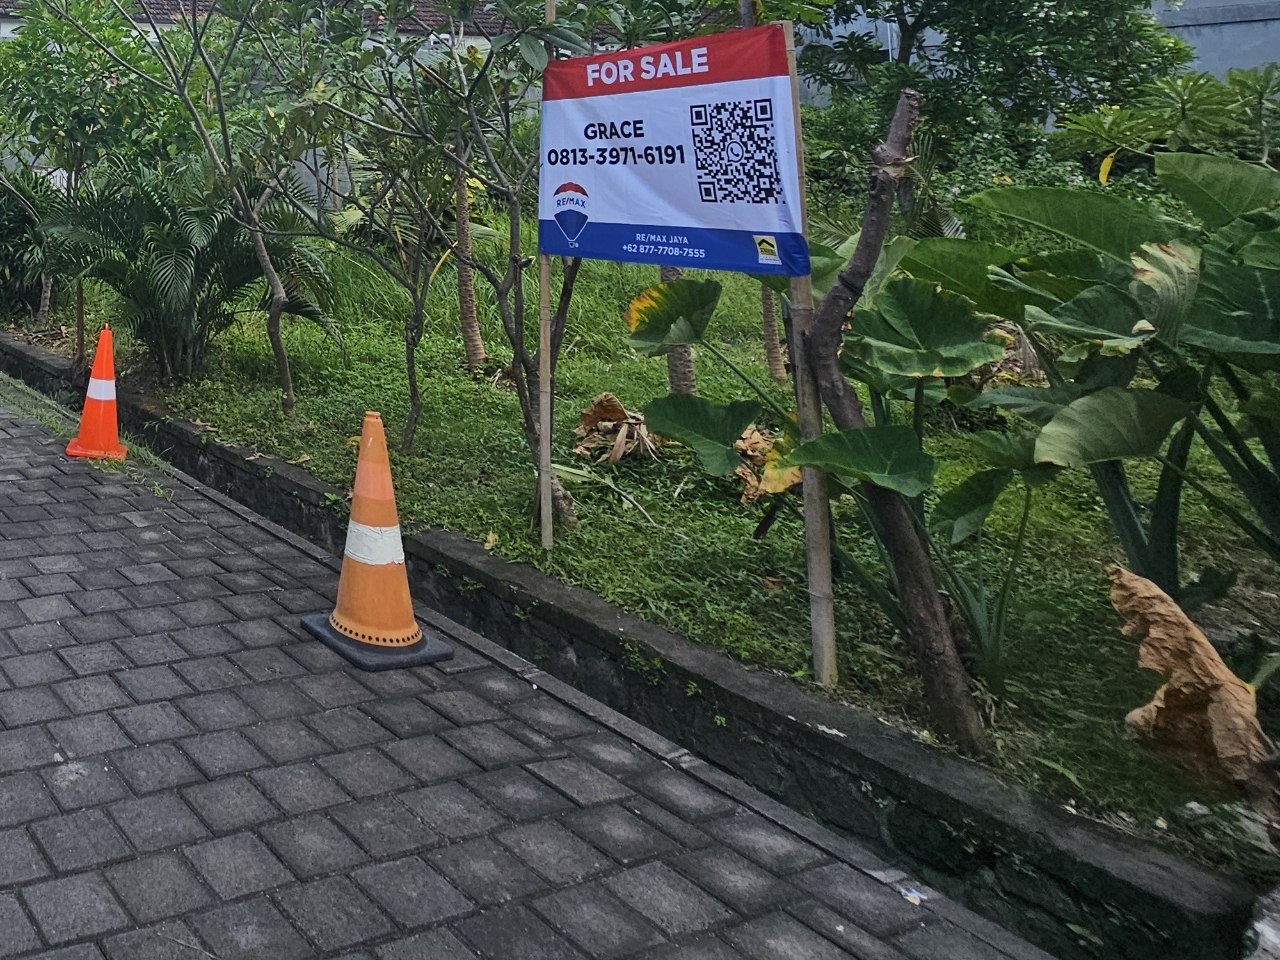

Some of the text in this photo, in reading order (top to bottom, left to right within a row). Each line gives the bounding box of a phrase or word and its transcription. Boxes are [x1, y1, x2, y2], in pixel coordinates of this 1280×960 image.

[586, 47, 709, 86] FOR SALE
[583, 120, 645, 140] GRACE
[547, 144, 686, 166] 0813-3971-6191
[556, 197, 586, 209] RE/MAX
[635, 233, 689, 245] RE/MAX JAYA
[622, 243, 706, 259] +62 877-7708-7555
